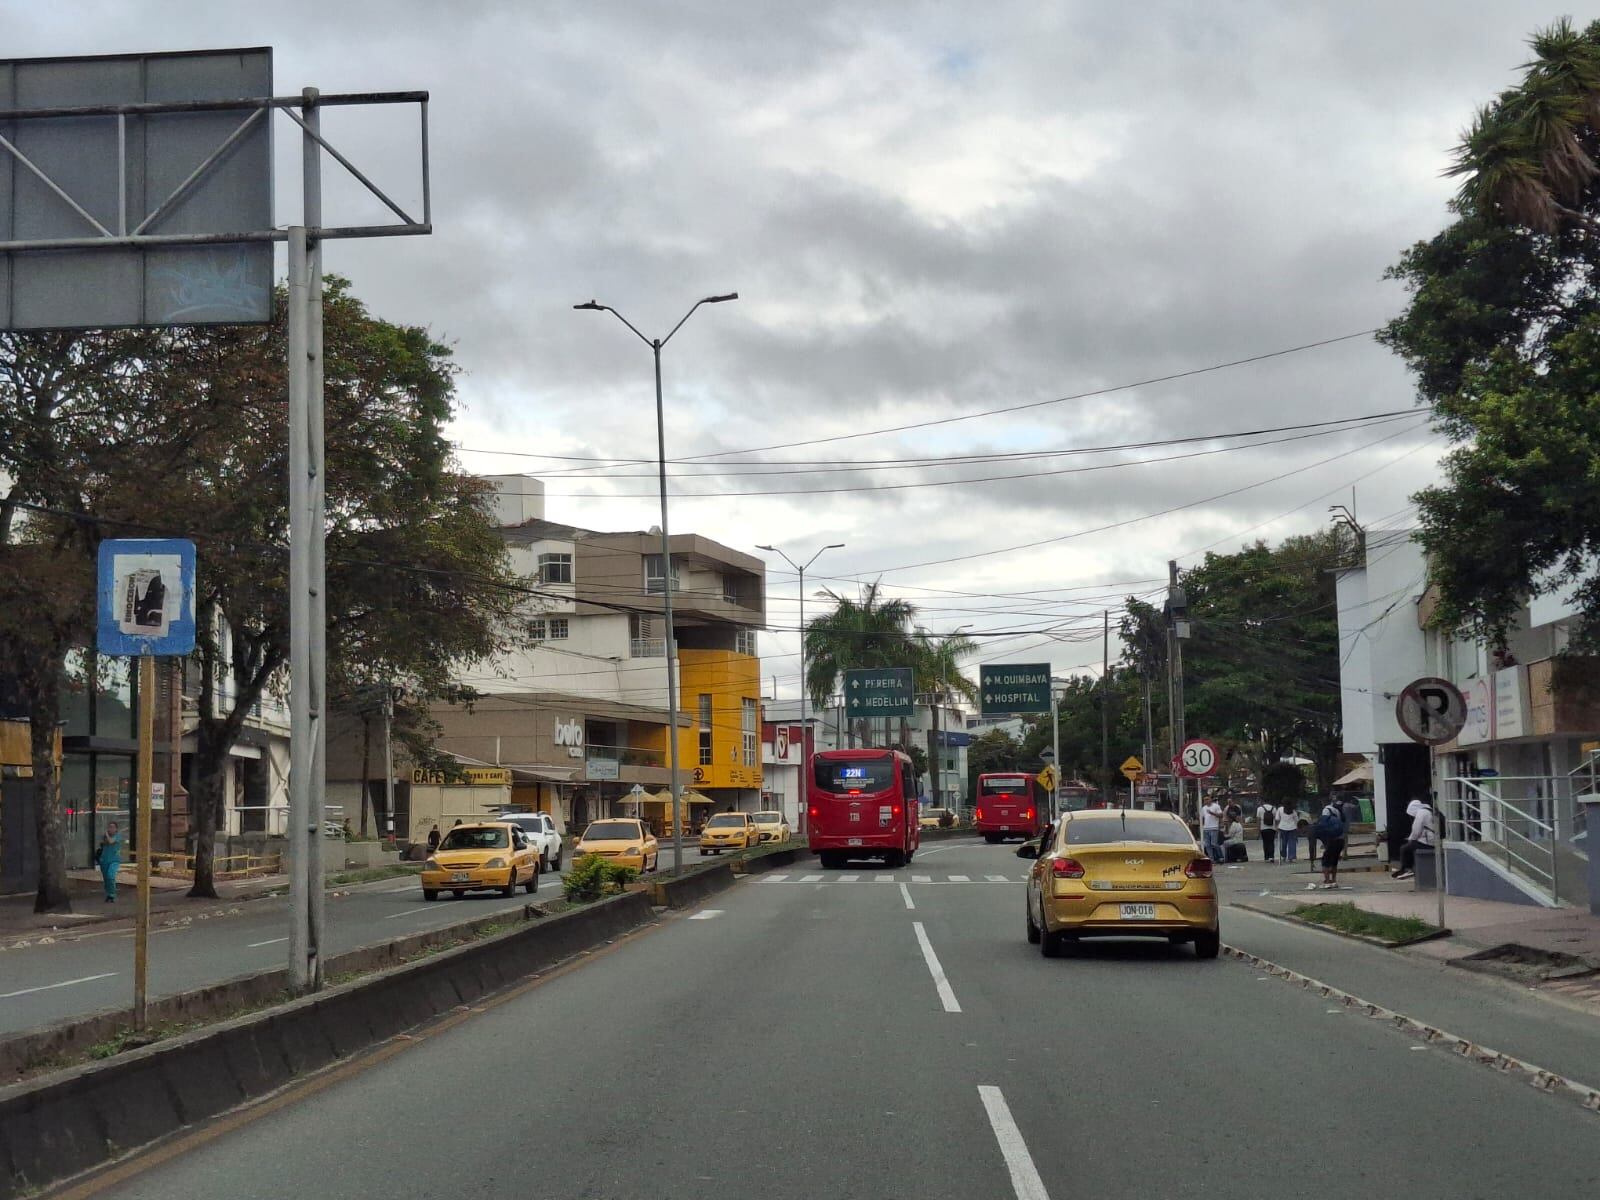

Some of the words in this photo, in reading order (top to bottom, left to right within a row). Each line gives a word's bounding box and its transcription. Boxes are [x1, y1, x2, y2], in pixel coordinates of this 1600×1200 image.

[865, 678, 903, 689] PEREIRA
[865, 696, 909, 707] MEDELLIN
[994, 692, 1040, 703] HOSPITAL
[1185, 748, 1212, 767] 30
[845, 768, 862, 778] 22N
